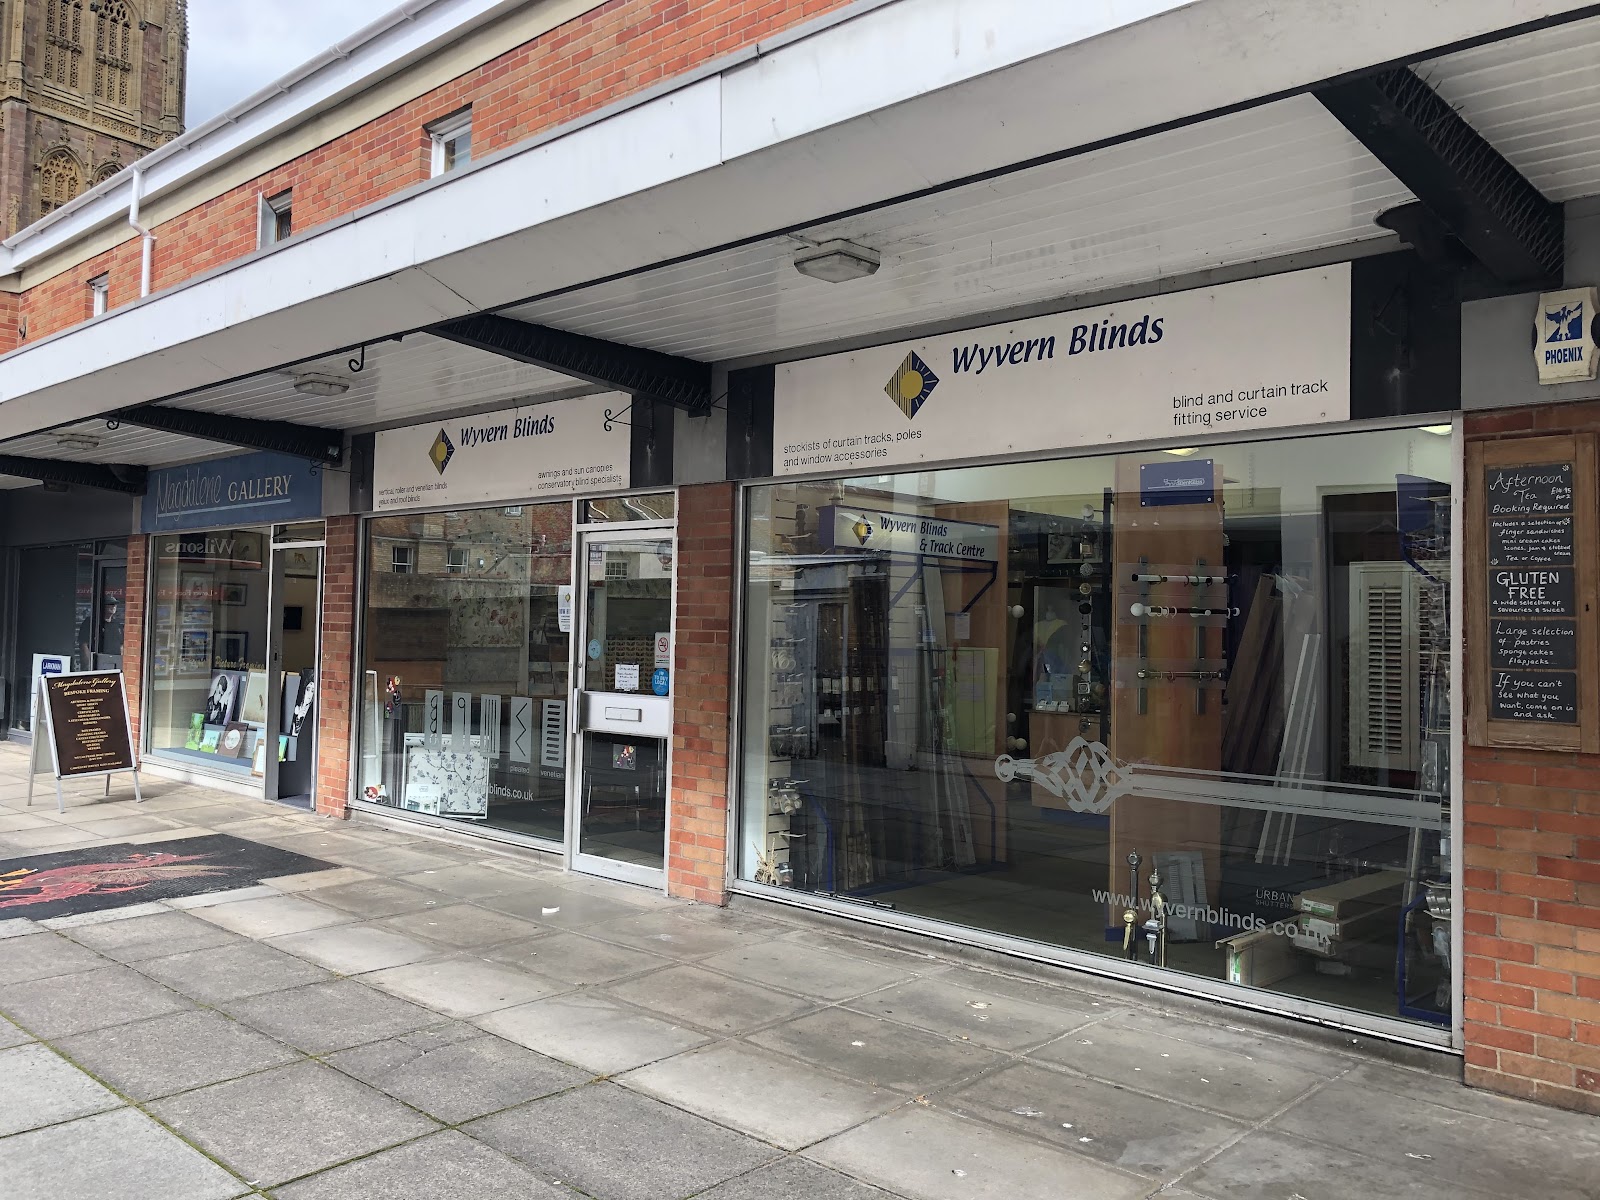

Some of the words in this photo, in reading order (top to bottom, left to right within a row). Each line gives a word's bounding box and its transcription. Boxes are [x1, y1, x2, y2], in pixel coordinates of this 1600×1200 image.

[952, 335, 1056, 375] Wyvern
[1068, 314, 1164, 356] Blinds
[1545, 346, 1584, 365] PHOENIX
[1173, 393, 1203, 409] blind
[1207, 390, 1233, 405] and
[1238, 384, 1287, 401] curtain
[1291, 379, 1328, 395] track
[1173, 411, 1211, 426] fitting
[1215, 406, 1267, 422] service
[460, 423, 508, 448] Wyvern
[513, 414, 555, 439] Blinds
[783, 441, 820, 454] stockists
[822, 438, 831, 449] of
[832, 436, 863, 448] curtain
[864, 432, 894, 445] tracks,
[896, 428, 922, 444] poles
[783, 455, 798, 467] and
[800, 453, 832, 465] window
[834, 447, 888, 462] accessories
[537, 469, 561, 479] awnings
[561, 467, 573, 476] and
[574, 467, 585, 475] sun
[585, 464, 613, 474] canopies
[406, 485, 414, 493] and
[434, 481, 448, 490] blinds
[537, 480, 575, 490] conservatory
[575, 477, 589, 486] blind
[590, 474, 622, 486] specialists
[1489, 472, 1564, 494] Afternoon
[155, 467, 222, 526] Magdalene
[227, 474, 292, 502] GALLERY
[1513, 487, 1538, 503] Tea
[1492, 503, 1531, 514] Booking
[1532, 502, 1570, 513] Required
[880, 516, 917, 534] Wyvern
[919, 521, 948, 537] Blinds
[1498, 528, 1525, 538] finger
[919, 538, 928, 552] &
[930, 539, 954, 554] Track
[956, 542, 985, 558] Centre
[1530, 555, 1551, 563] Coffee
[1496, 571, 1560, 587] GLUTEN
[1507, 586, 1546, 599] FREE
[1495, 621, 1528, 639] Large
[1531, 626, 1574, 636] selection
[1498, 638, 1506, 646] of
[1514, 639, 1550, 647] pastries
[1495, 672, 1511, 692] If
[1510, 679, 1535, 691] you
[1537, 679, 1563, 688] can't
[63, 689, 87, 697] BESPOKE
[1516, 691, 1539, 699] what
[1541, 693, 1560, 702] you
[1513, 710, 1533, 718] and
[1525, 703, 1548, 711] come
[1565, 703, 1574, 711] in
[540, 769, 565, 779] venetian
[1255, 888, 1295, 903] URBAN
